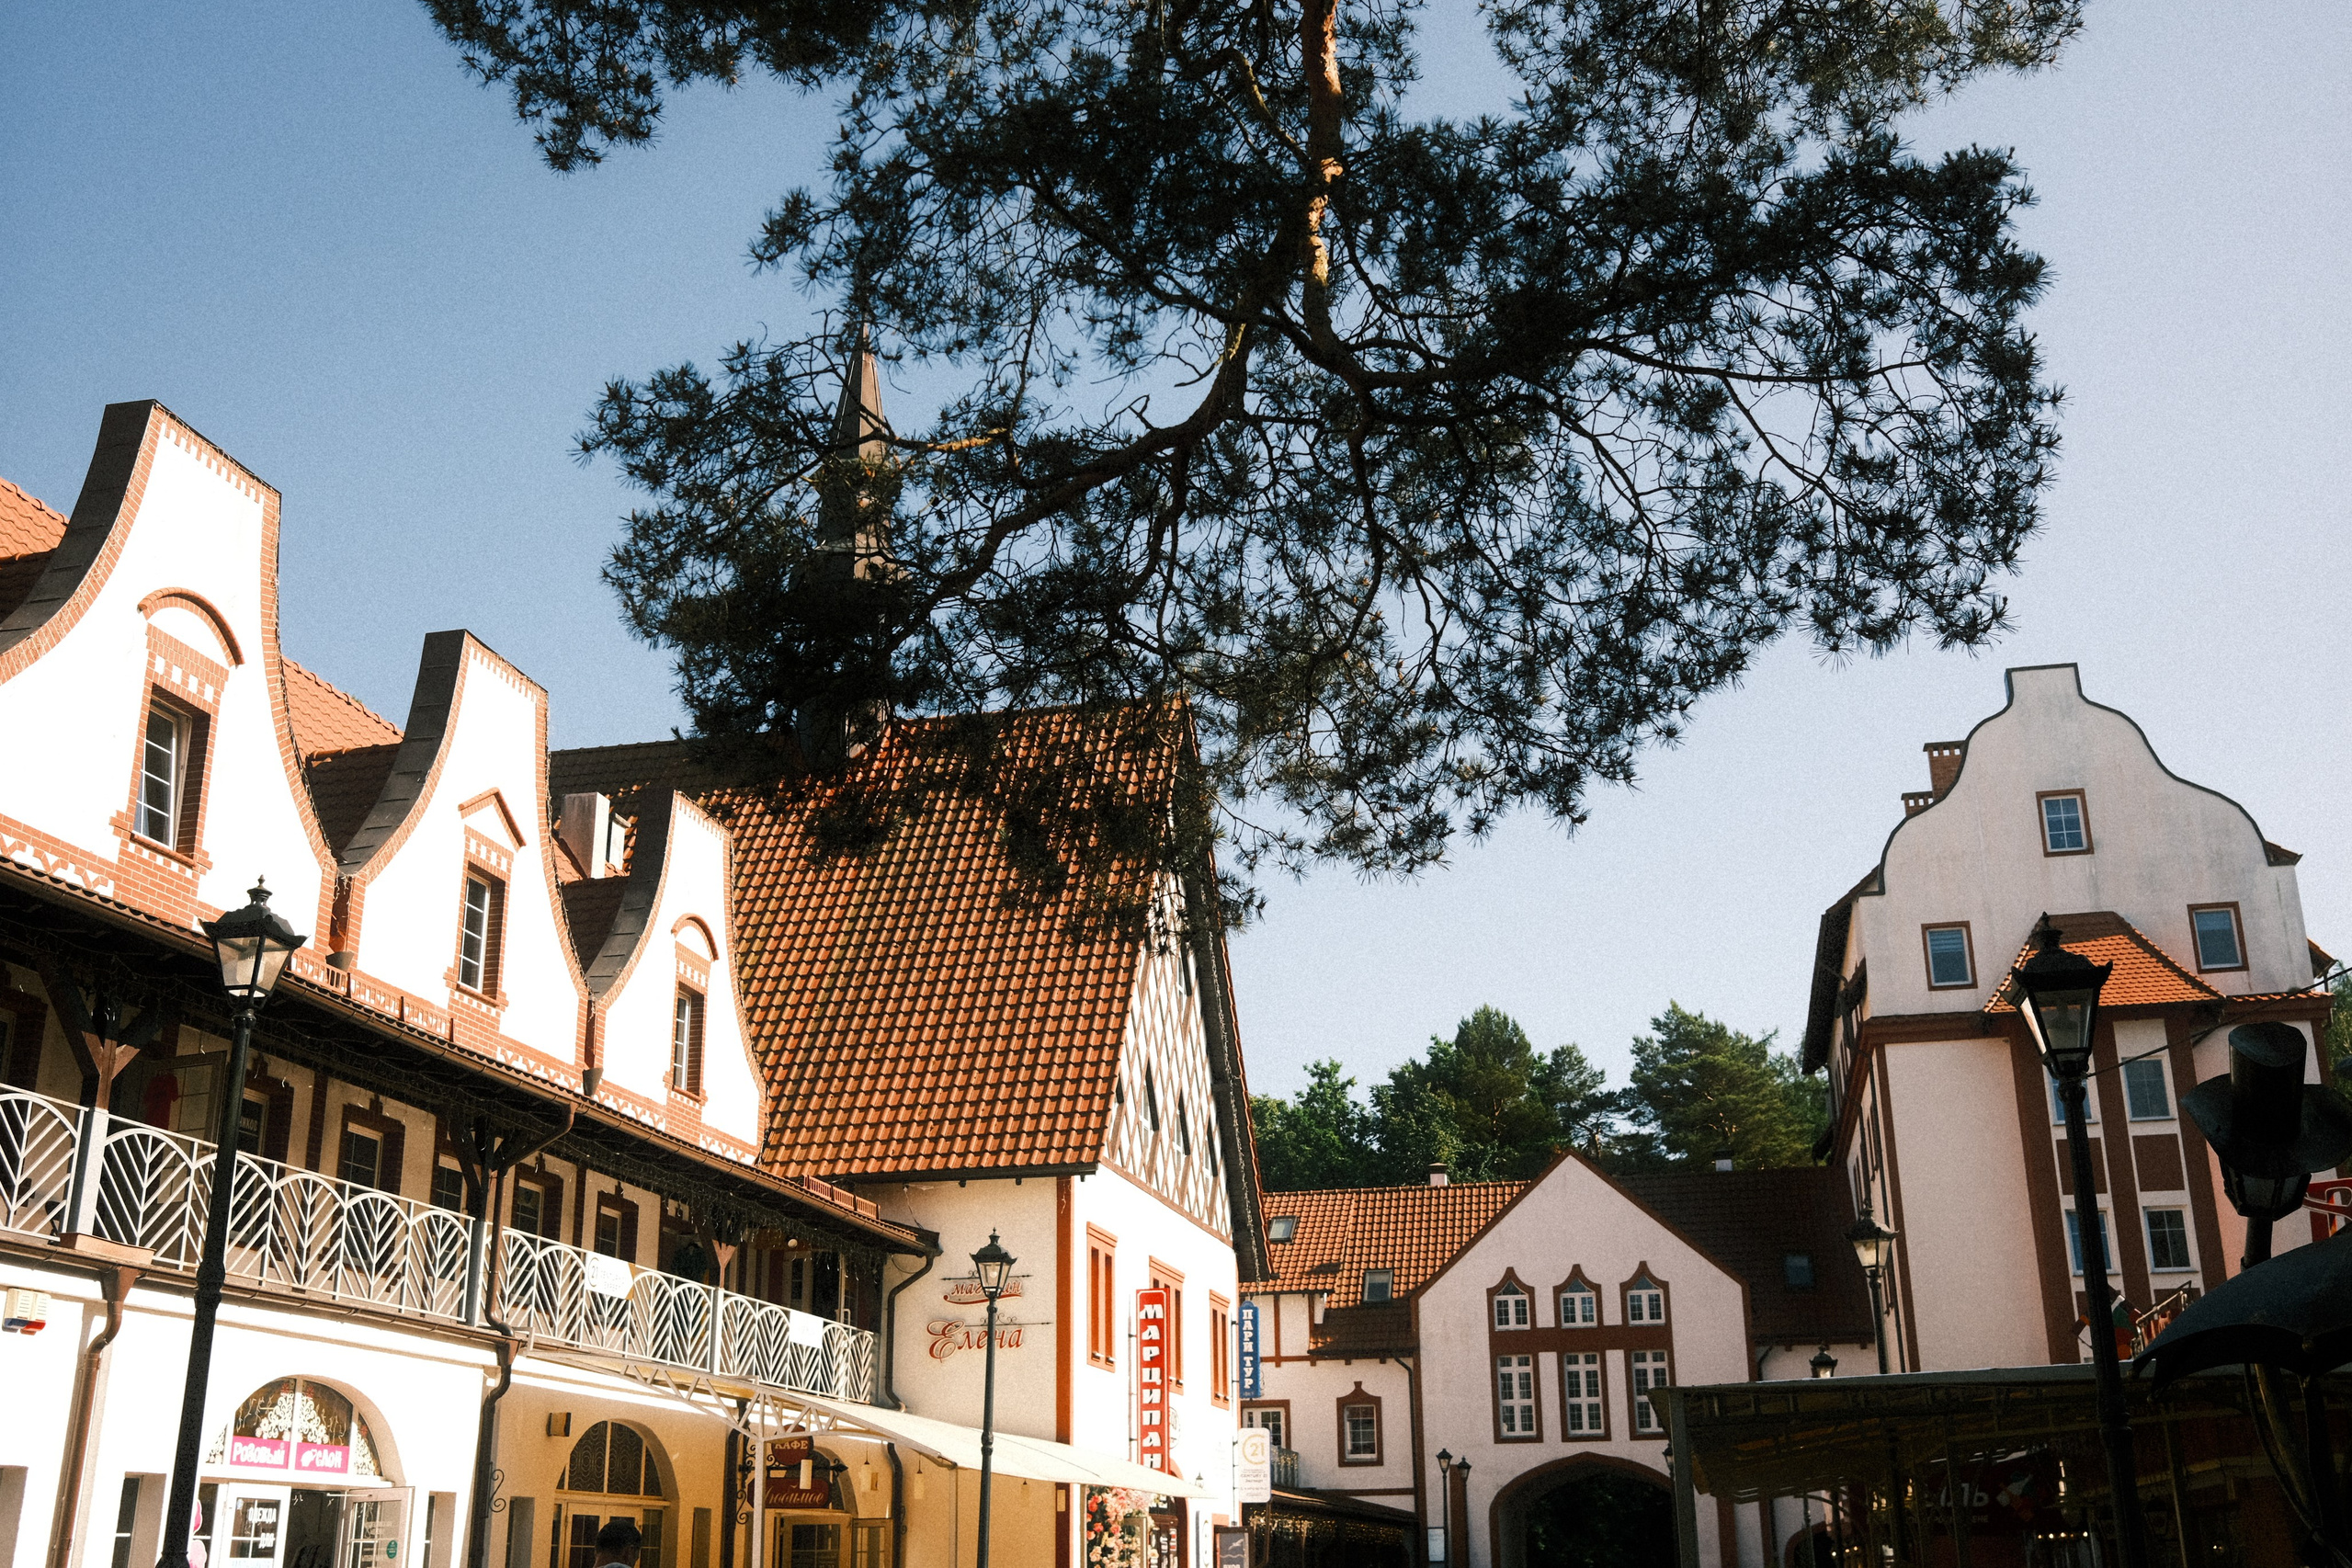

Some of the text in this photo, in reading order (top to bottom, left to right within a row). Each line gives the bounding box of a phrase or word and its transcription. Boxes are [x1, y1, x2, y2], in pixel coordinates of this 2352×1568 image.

[950, 1280, 1022, 1296] магин
[926, 1318, 1024, 1364] Елена
[1242, 1309, 1254, 1353] ПАРИ
[1139, 1303, 1165, 1469] МАРЦИПАН
[1243, 1356, 1254, 1389] ТУР
[774, 1439, 809, 1449] КАФЕ
